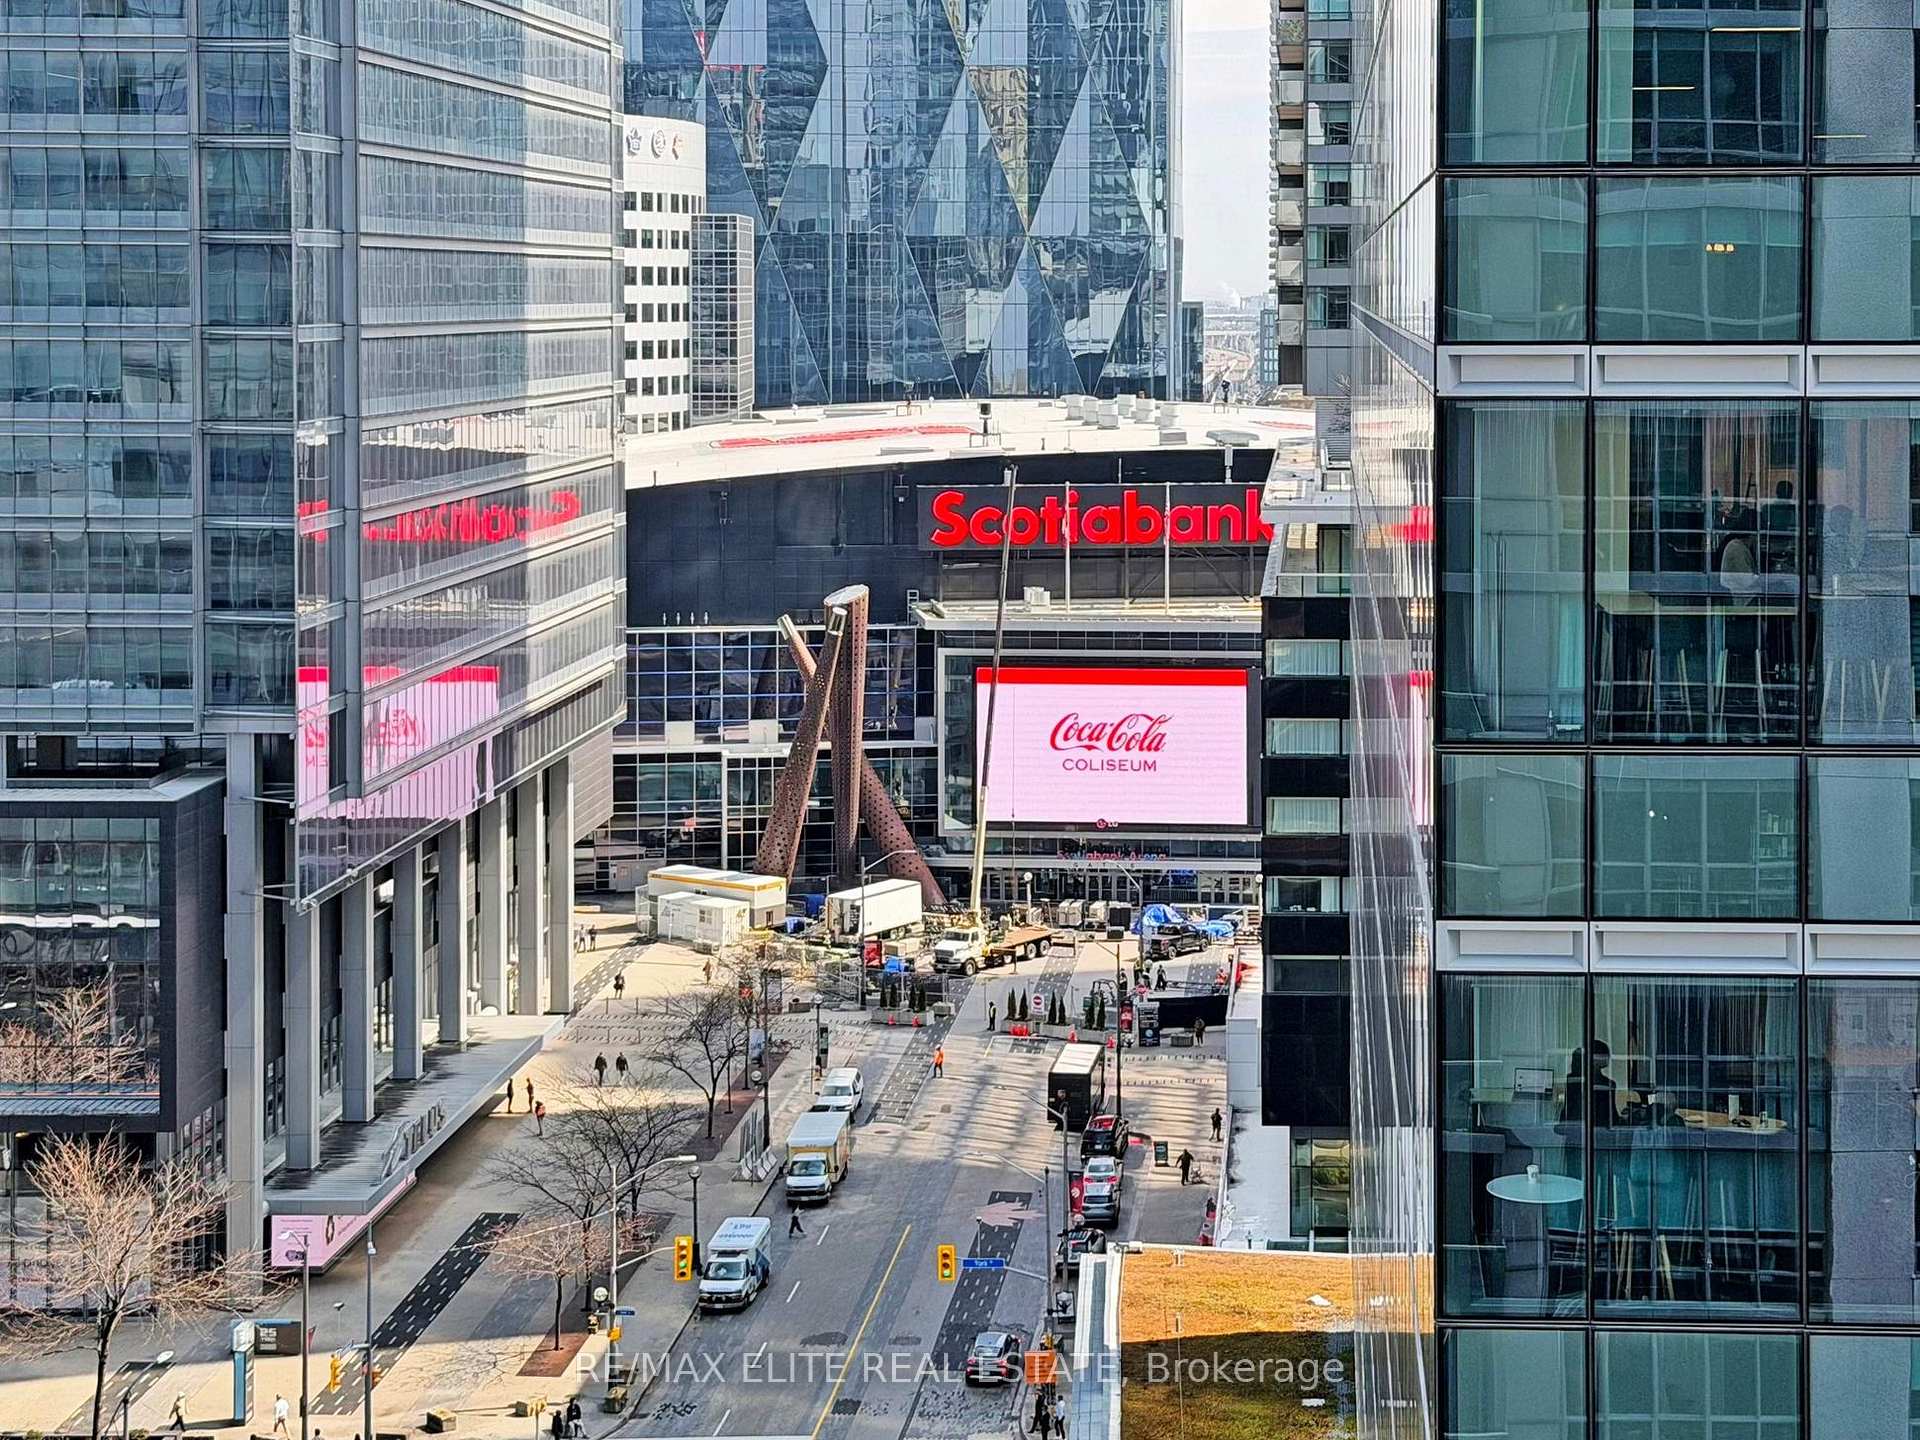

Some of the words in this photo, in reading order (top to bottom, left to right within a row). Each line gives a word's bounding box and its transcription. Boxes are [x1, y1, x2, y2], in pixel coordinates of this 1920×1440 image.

[931, 490, 1274, 547] Scotiabank
[1050, 713, 1174, 752] Coca-Cola
[1062, 758, 1157, 771] COLISEUM
[1130, 851, 1168, 862] Arena
